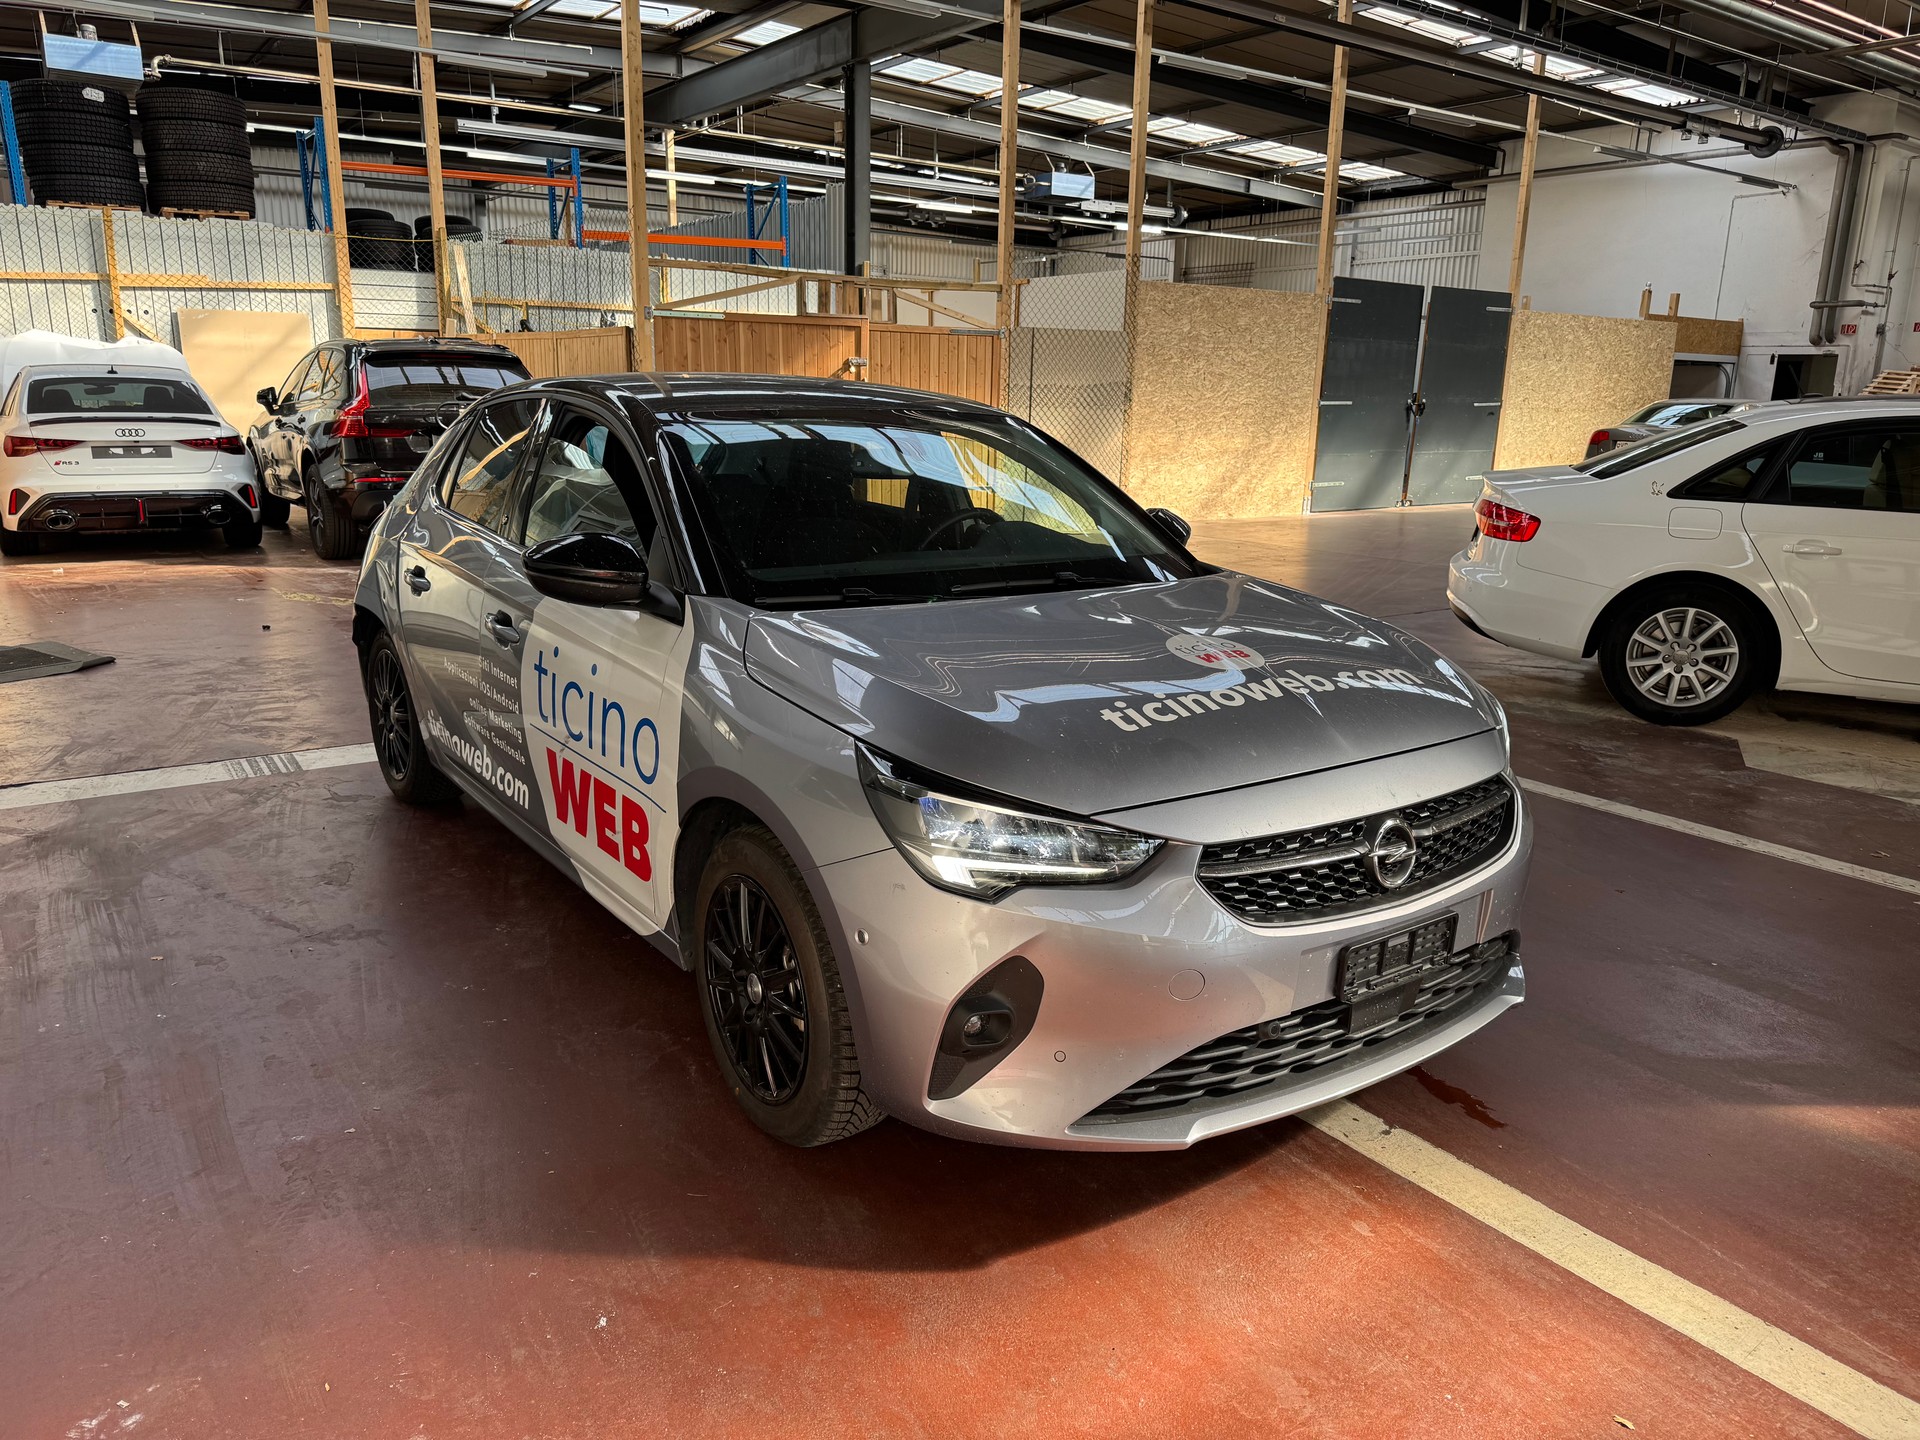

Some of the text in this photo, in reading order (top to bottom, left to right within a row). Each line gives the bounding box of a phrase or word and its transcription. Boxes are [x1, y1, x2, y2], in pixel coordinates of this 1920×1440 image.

[443, 656, 520, 715] Applicazioni iOS/Android
[478, 655, 518, 689] Siti Internet
[1100, 667, 1425, 732] ticinoweb.com
[463, 711, 526, 765] Software Gestionale
[469, 697, 522, 744] online Marketing
[533, 646, 660, 785] ticino
[545, 746, 652, 883] WEB
